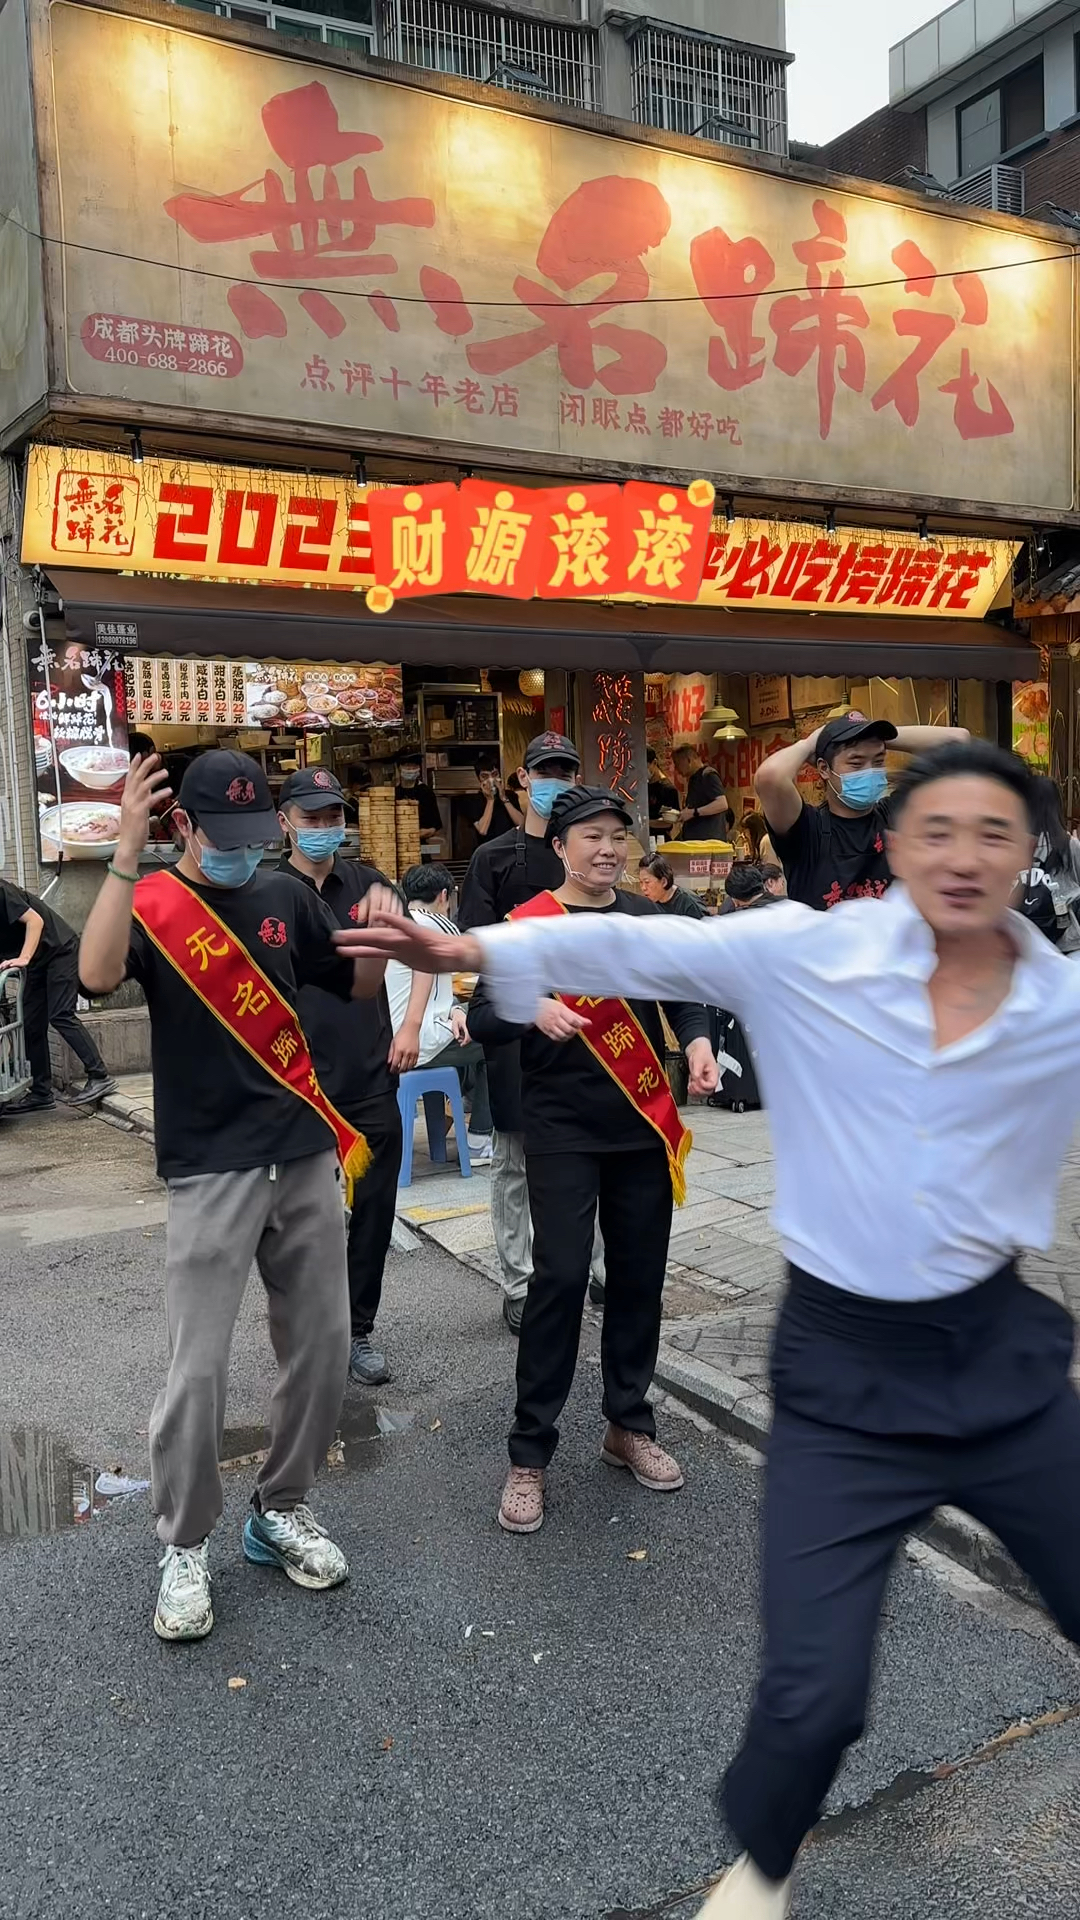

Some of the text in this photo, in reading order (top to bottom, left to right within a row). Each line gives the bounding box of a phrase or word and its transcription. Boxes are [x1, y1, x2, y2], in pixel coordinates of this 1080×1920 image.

[90, 317, 234, 358] 成都头牌蹄花
[104, 347, 228, 376] 400-688-2866
[299, 354, 743, 445] 点评十年老店 闭眼点都好吃
